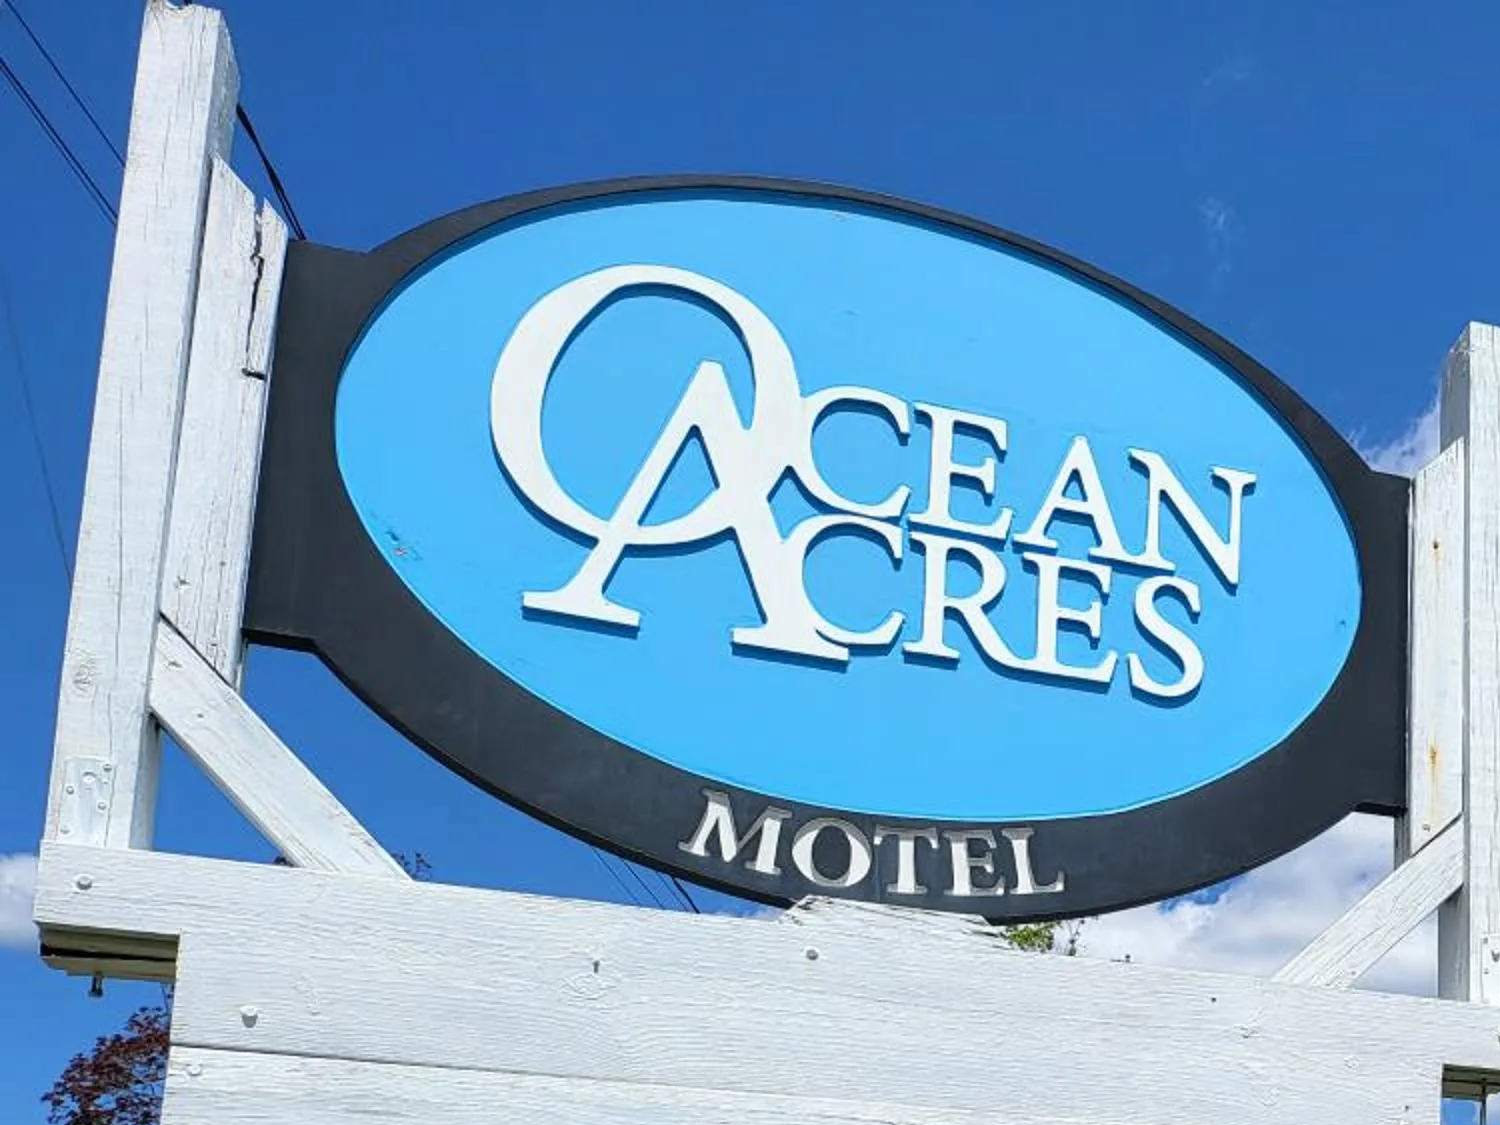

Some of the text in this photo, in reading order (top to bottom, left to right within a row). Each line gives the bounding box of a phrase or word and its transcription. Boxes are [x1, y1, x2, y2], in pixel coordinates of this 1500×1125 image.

[490, 264, 1257, 586] OCEAN
[521, 360, 1205, 699] ACRES
[678, 788, 1065, 897] MOTEL
